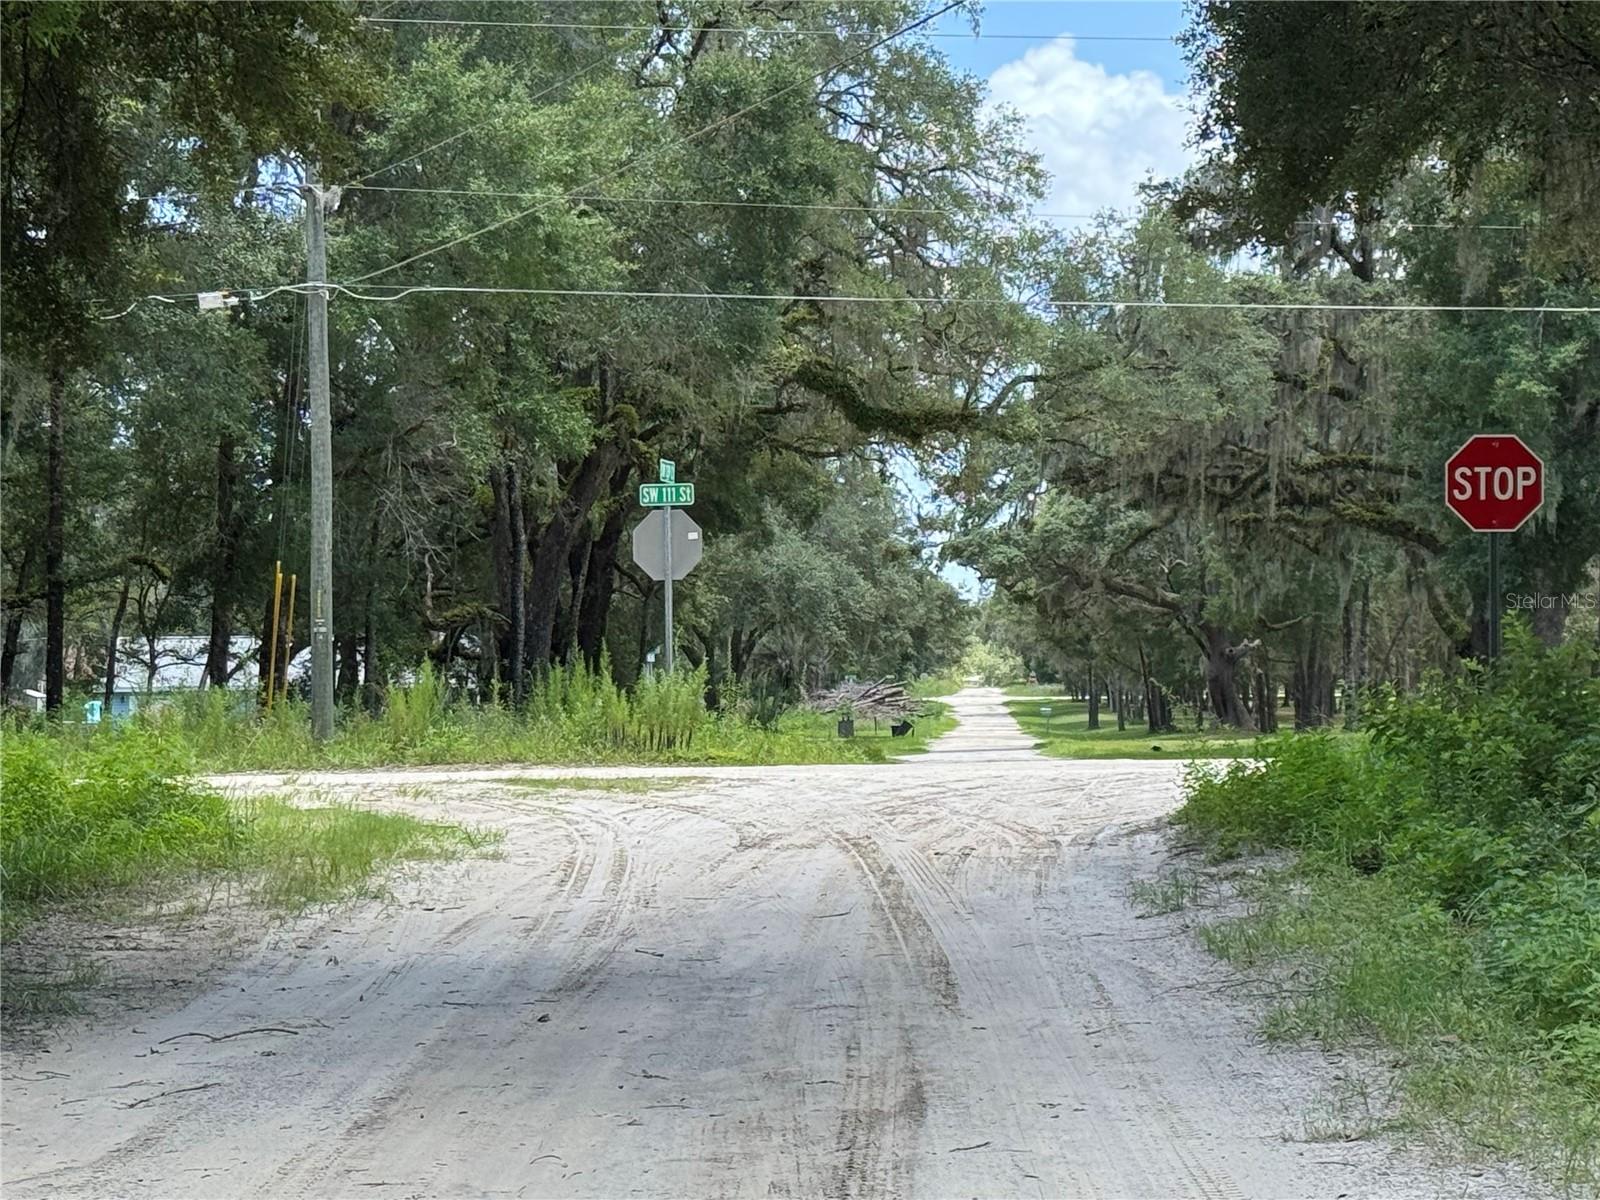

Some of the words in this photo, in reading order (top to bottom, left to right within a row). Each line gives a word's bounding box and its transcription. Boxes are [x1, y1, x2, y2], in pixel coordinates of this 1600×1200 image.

[643, 487, 658, 503] SW
[662, 487, 675, 502] 111
[679, 486, 692, 502] St
[1453, 466, 1537, 501] STOP
